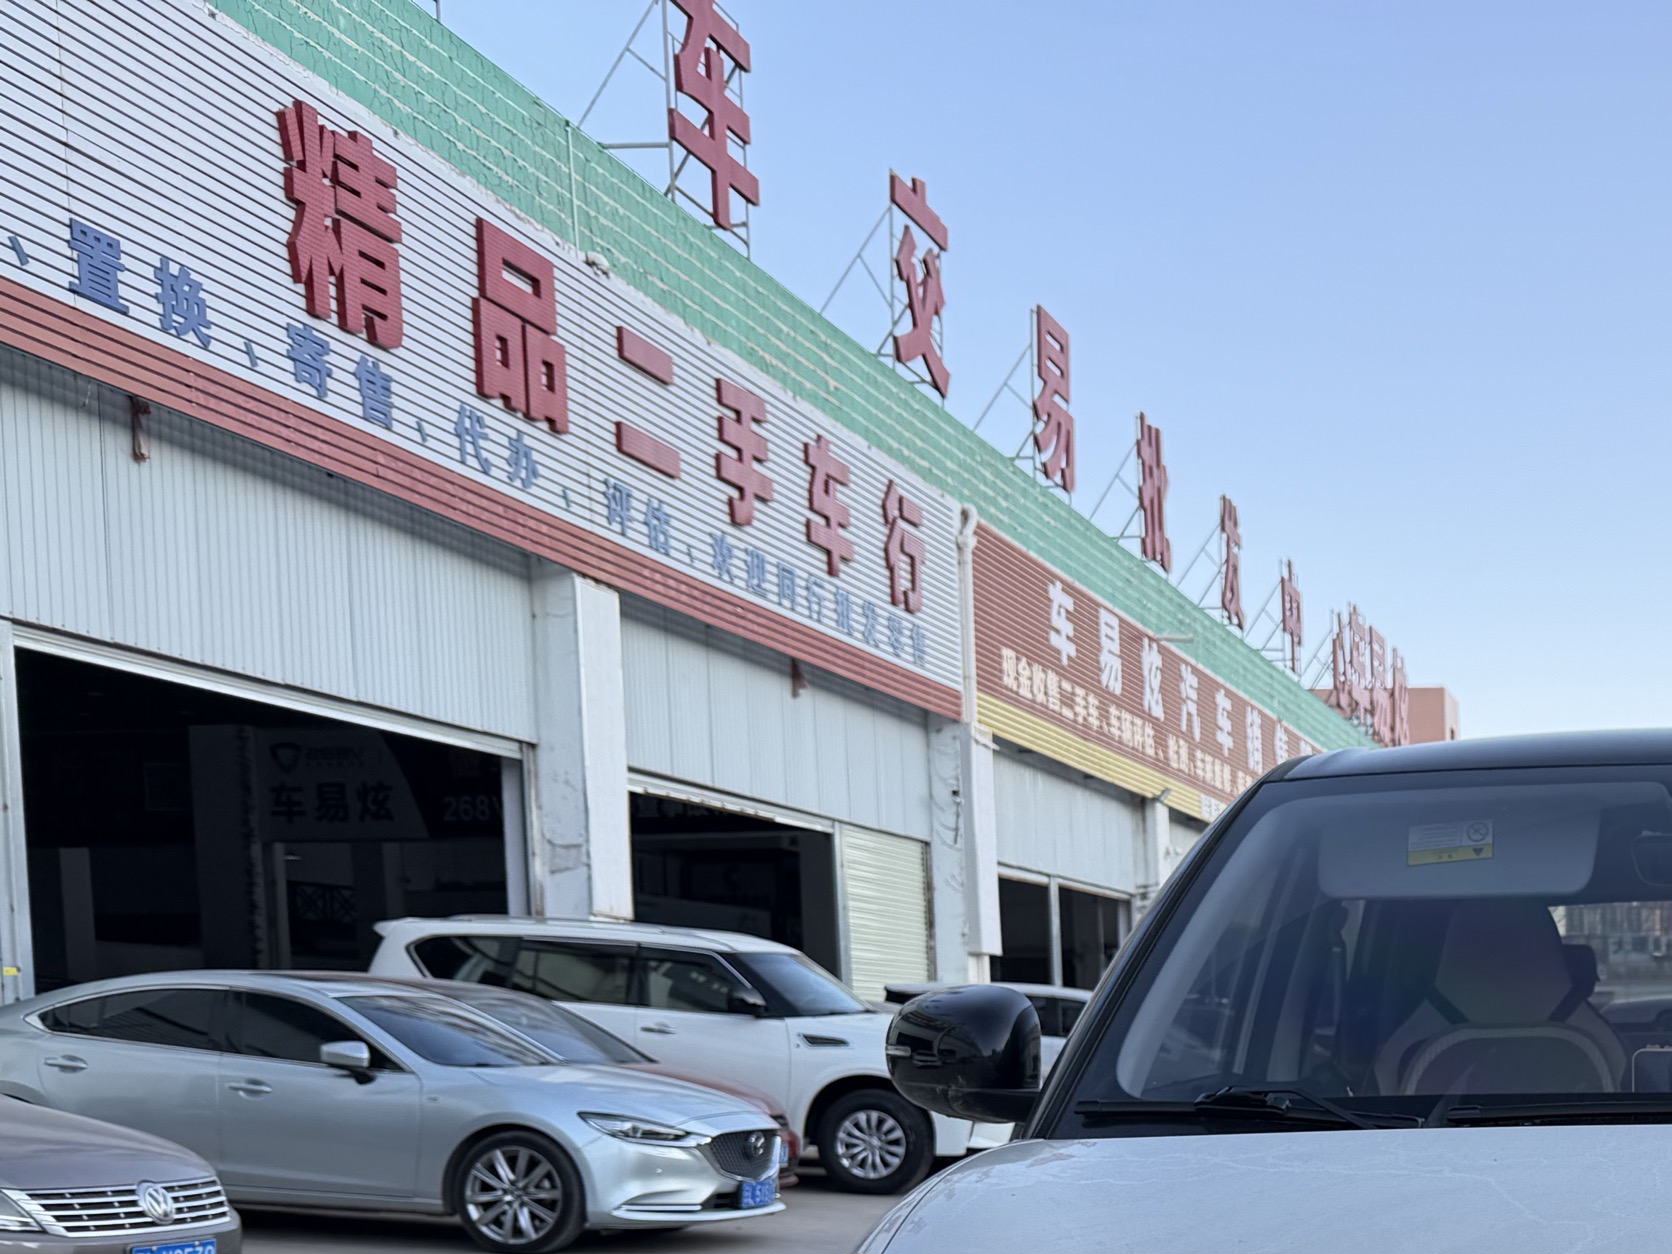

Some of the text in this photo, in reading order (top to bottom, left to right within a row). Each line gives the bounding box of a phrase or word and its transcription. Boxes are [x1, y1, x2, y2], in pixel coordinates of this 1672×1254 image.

[274, 99, 926, 615] 精品二手车行
[1048, 580, 1312, 773] 车易炫汽车销售
[270, 779, 395, 823] 车易炫
